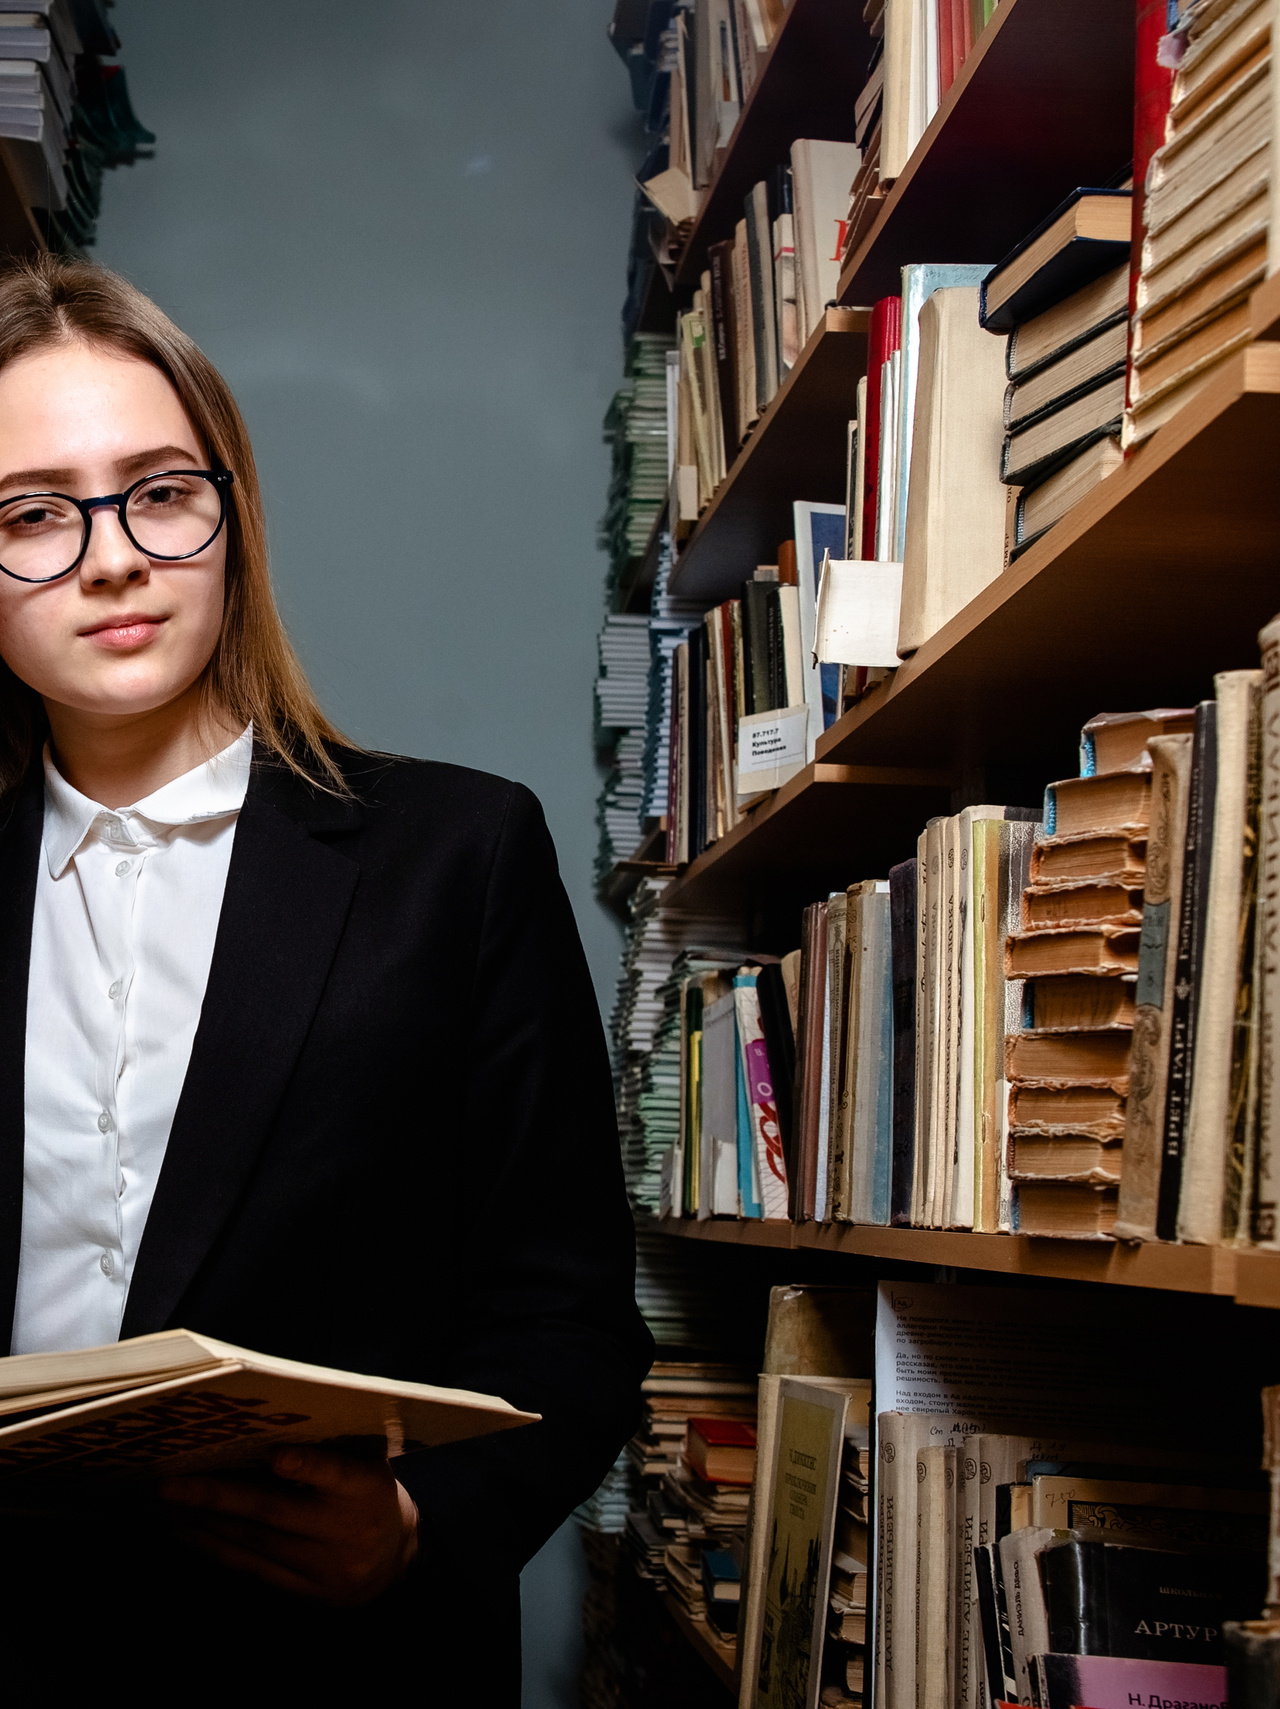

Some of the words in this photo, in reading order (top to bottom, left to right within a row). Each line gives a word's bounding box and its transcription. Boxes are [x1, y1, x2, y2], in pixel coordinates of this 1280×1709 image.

[752, 738, 781, 748] Культура
[752, 745, 786, 756] Поведения
[896, 1352, 909, 1360] Да,
[896, 1360, 938, 1369] рассказав,
[896, 1376, 941, 1384] решимость.
[913, 1391, 941, 1399] входом
[896, 1398, 926, 1406] входом,
[928, 1399, 954, 1407] стонут
[911, 1406, 950, 1414] свирепый
[952, 1408, 976, 1416] Харон
[885, 1495, 894, 1597] АЛИГЬЕРИ
[961, 1514, 974, 1624] АЛИГЬЕРИ
[1014, 1591, 1024, 1636] ДАНИЭЛЬ
[1133, 1618, 1219, 1643] АРТУР
[884, 1603, 893, 1671] ДАНТЕ
[960, 1629, 971, 1702] ДАНТЕ
[1127, 1692, 1145, 1706] Н.
